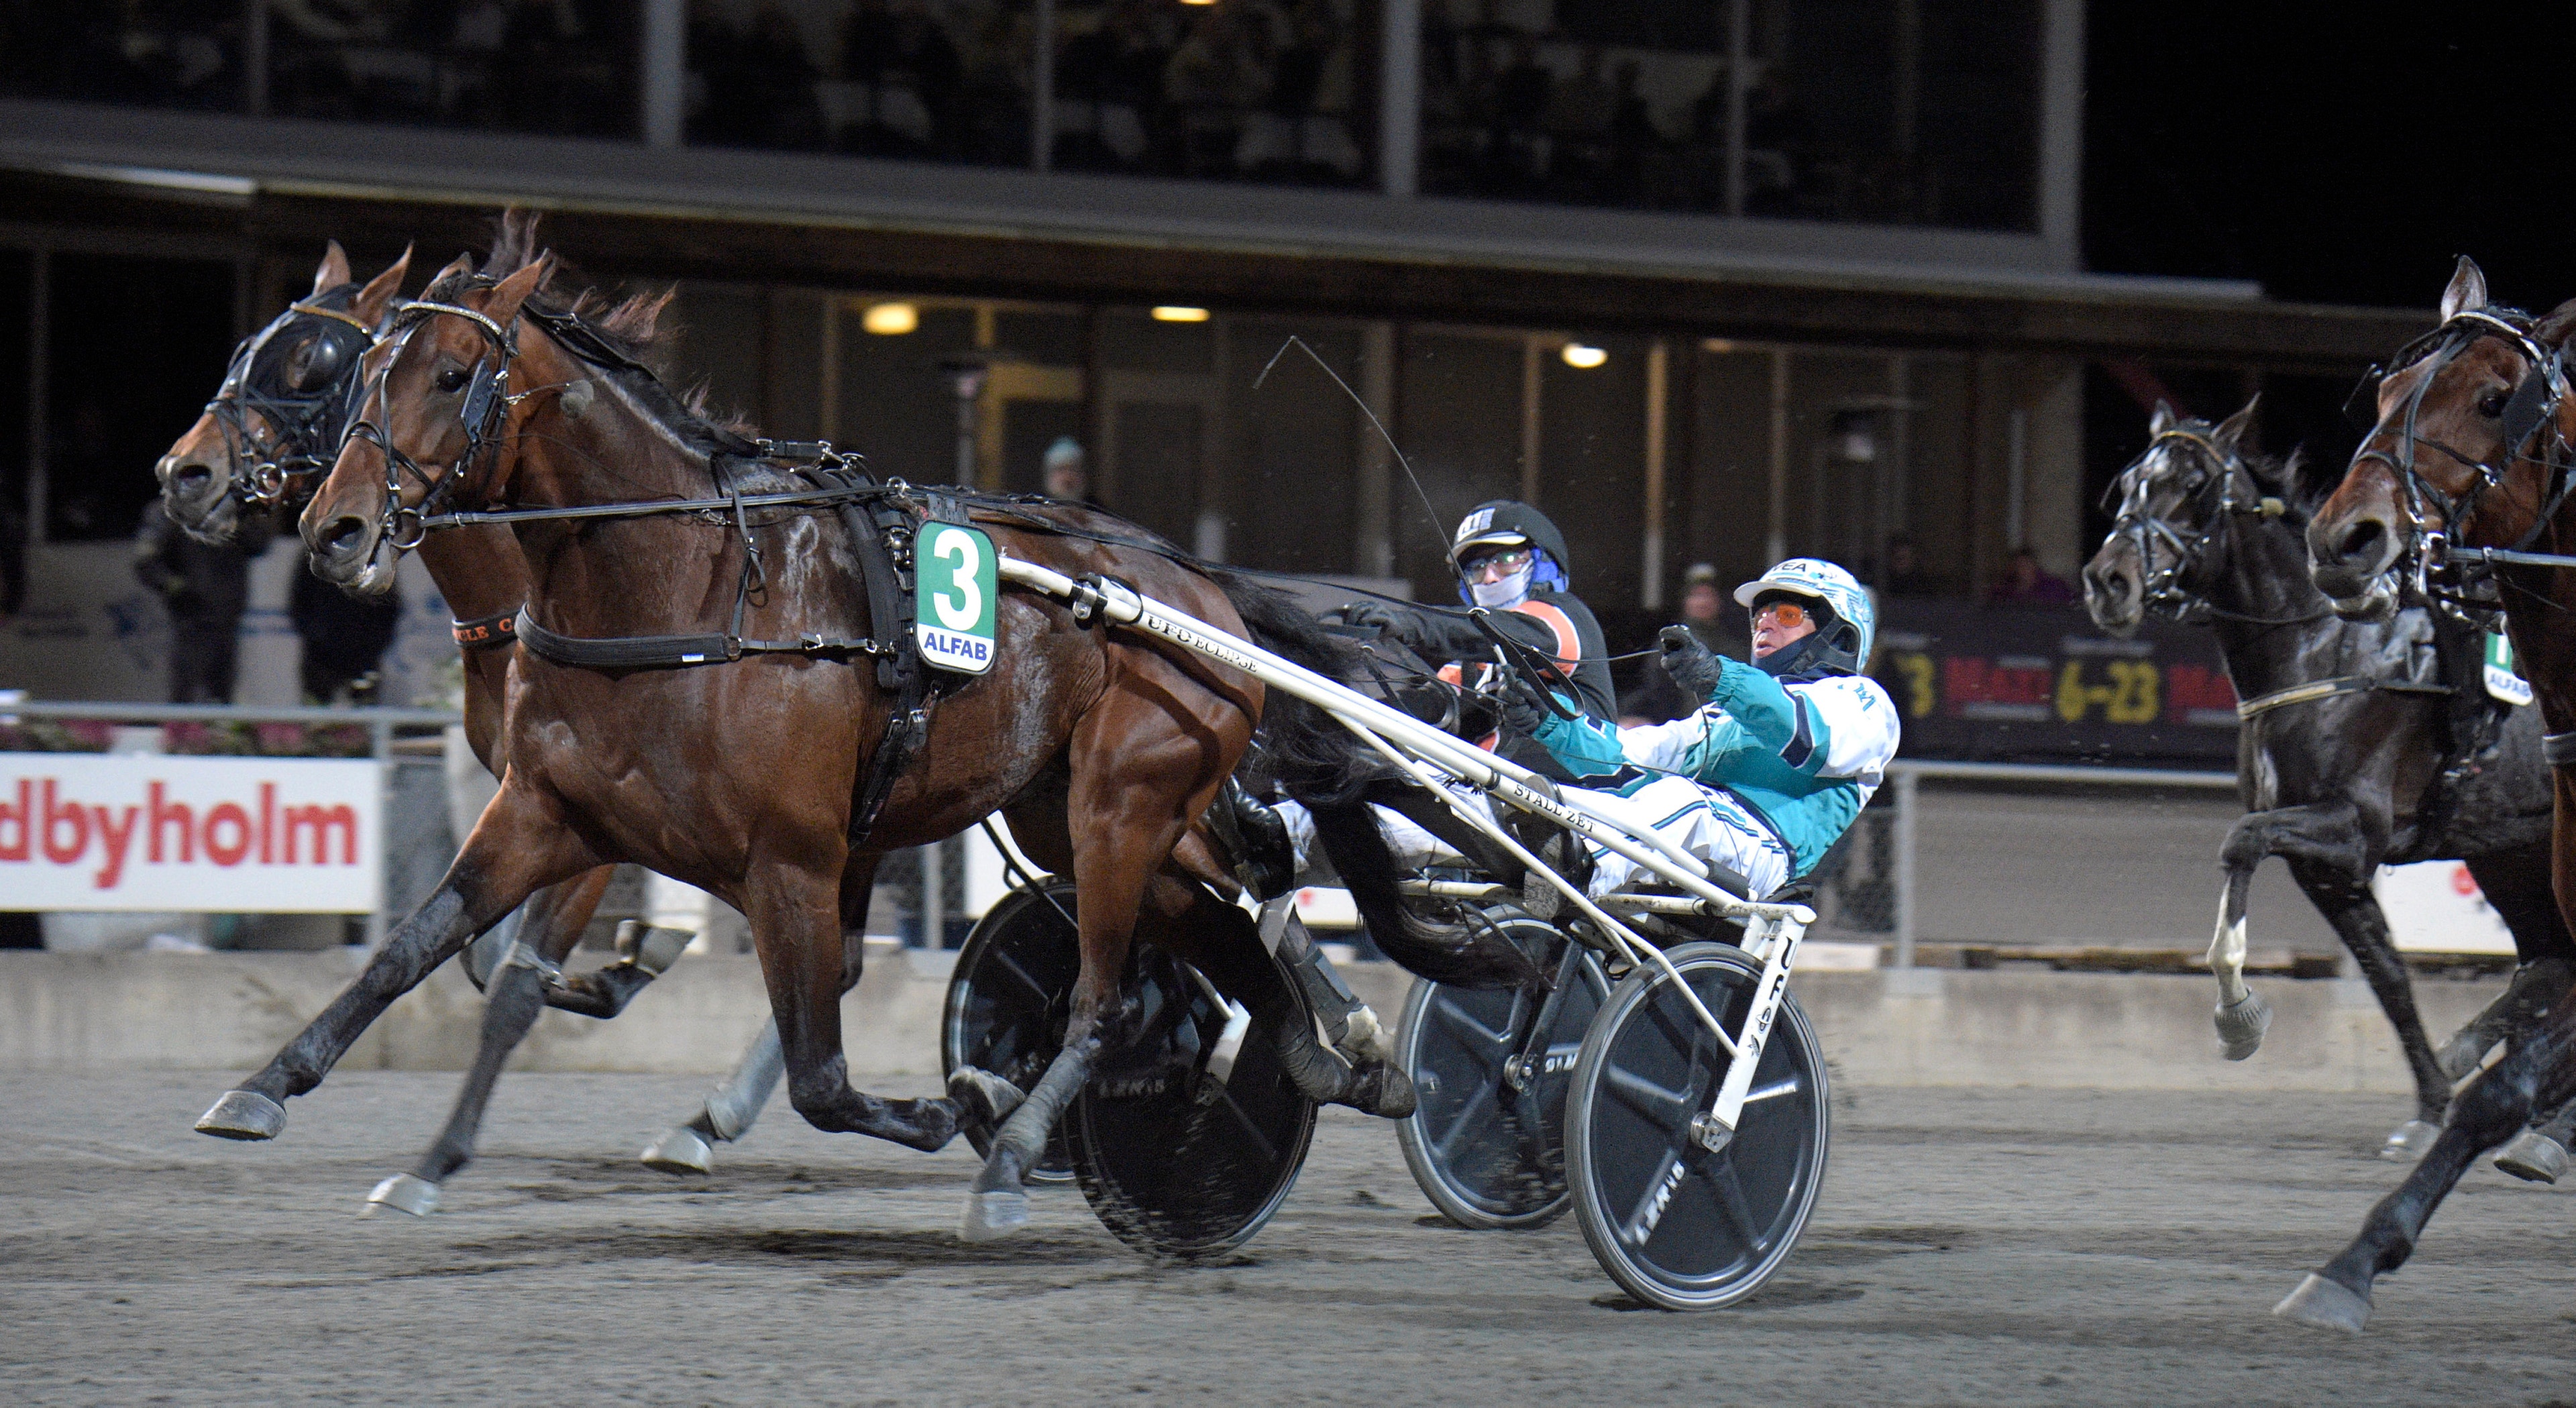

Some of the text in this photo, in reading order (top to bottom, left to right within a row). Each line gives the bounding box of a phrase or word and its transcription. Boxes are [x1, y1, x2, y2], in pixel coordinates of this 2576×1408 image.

[932, 528, 982, 632] 3
[924, 632, 987, 661] ALFAB
[1148, 615, 1257, 673] UFO ECLIPSE
[0, 777, 358, 890] dbyholm
[1513, 783, 1597, 832] STALL ZET
